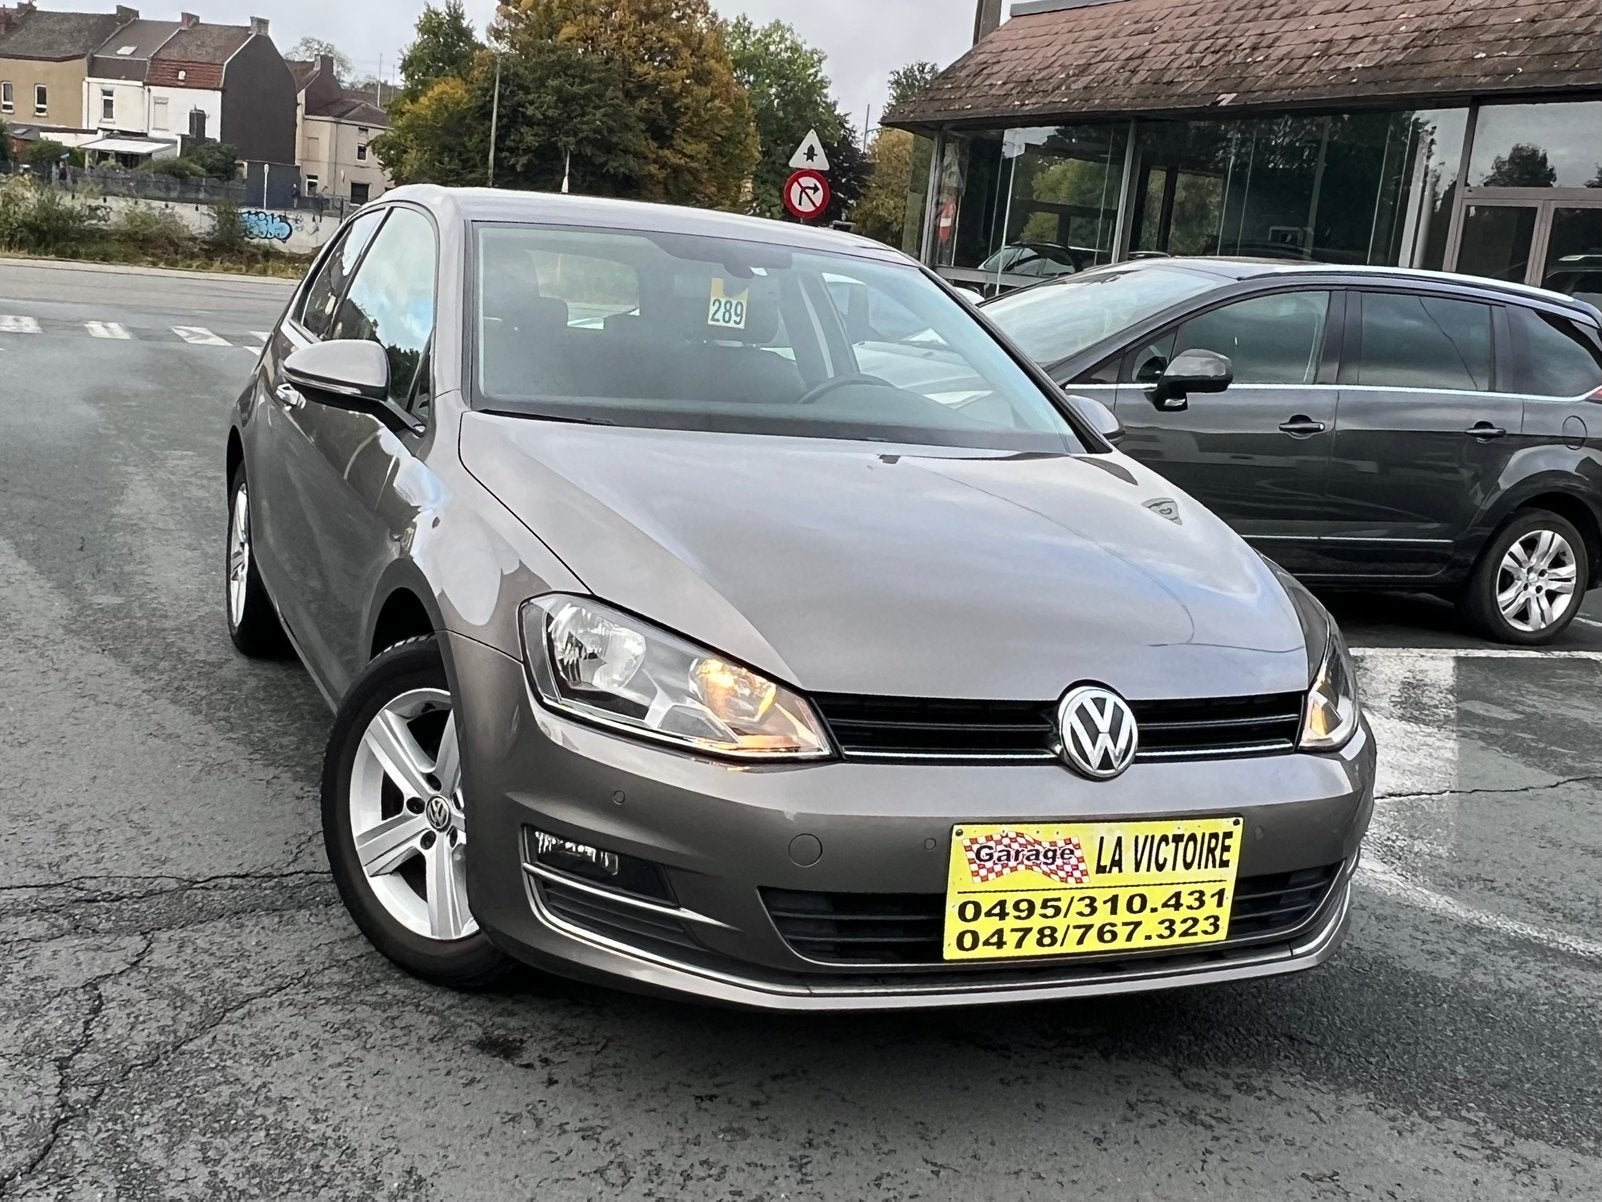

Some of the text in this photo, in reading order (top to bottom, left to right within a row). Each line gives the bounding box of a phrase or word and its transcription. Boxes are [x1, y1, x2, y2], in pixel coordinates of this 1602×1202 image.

[710, 298, 744, 325] 289
[974, 830, 1234, 875] Garage LA VICTOIRE
[957, 888, 1226, 923] 0495/310.431
[955, 915, 1221, 952] 0478/767.323
